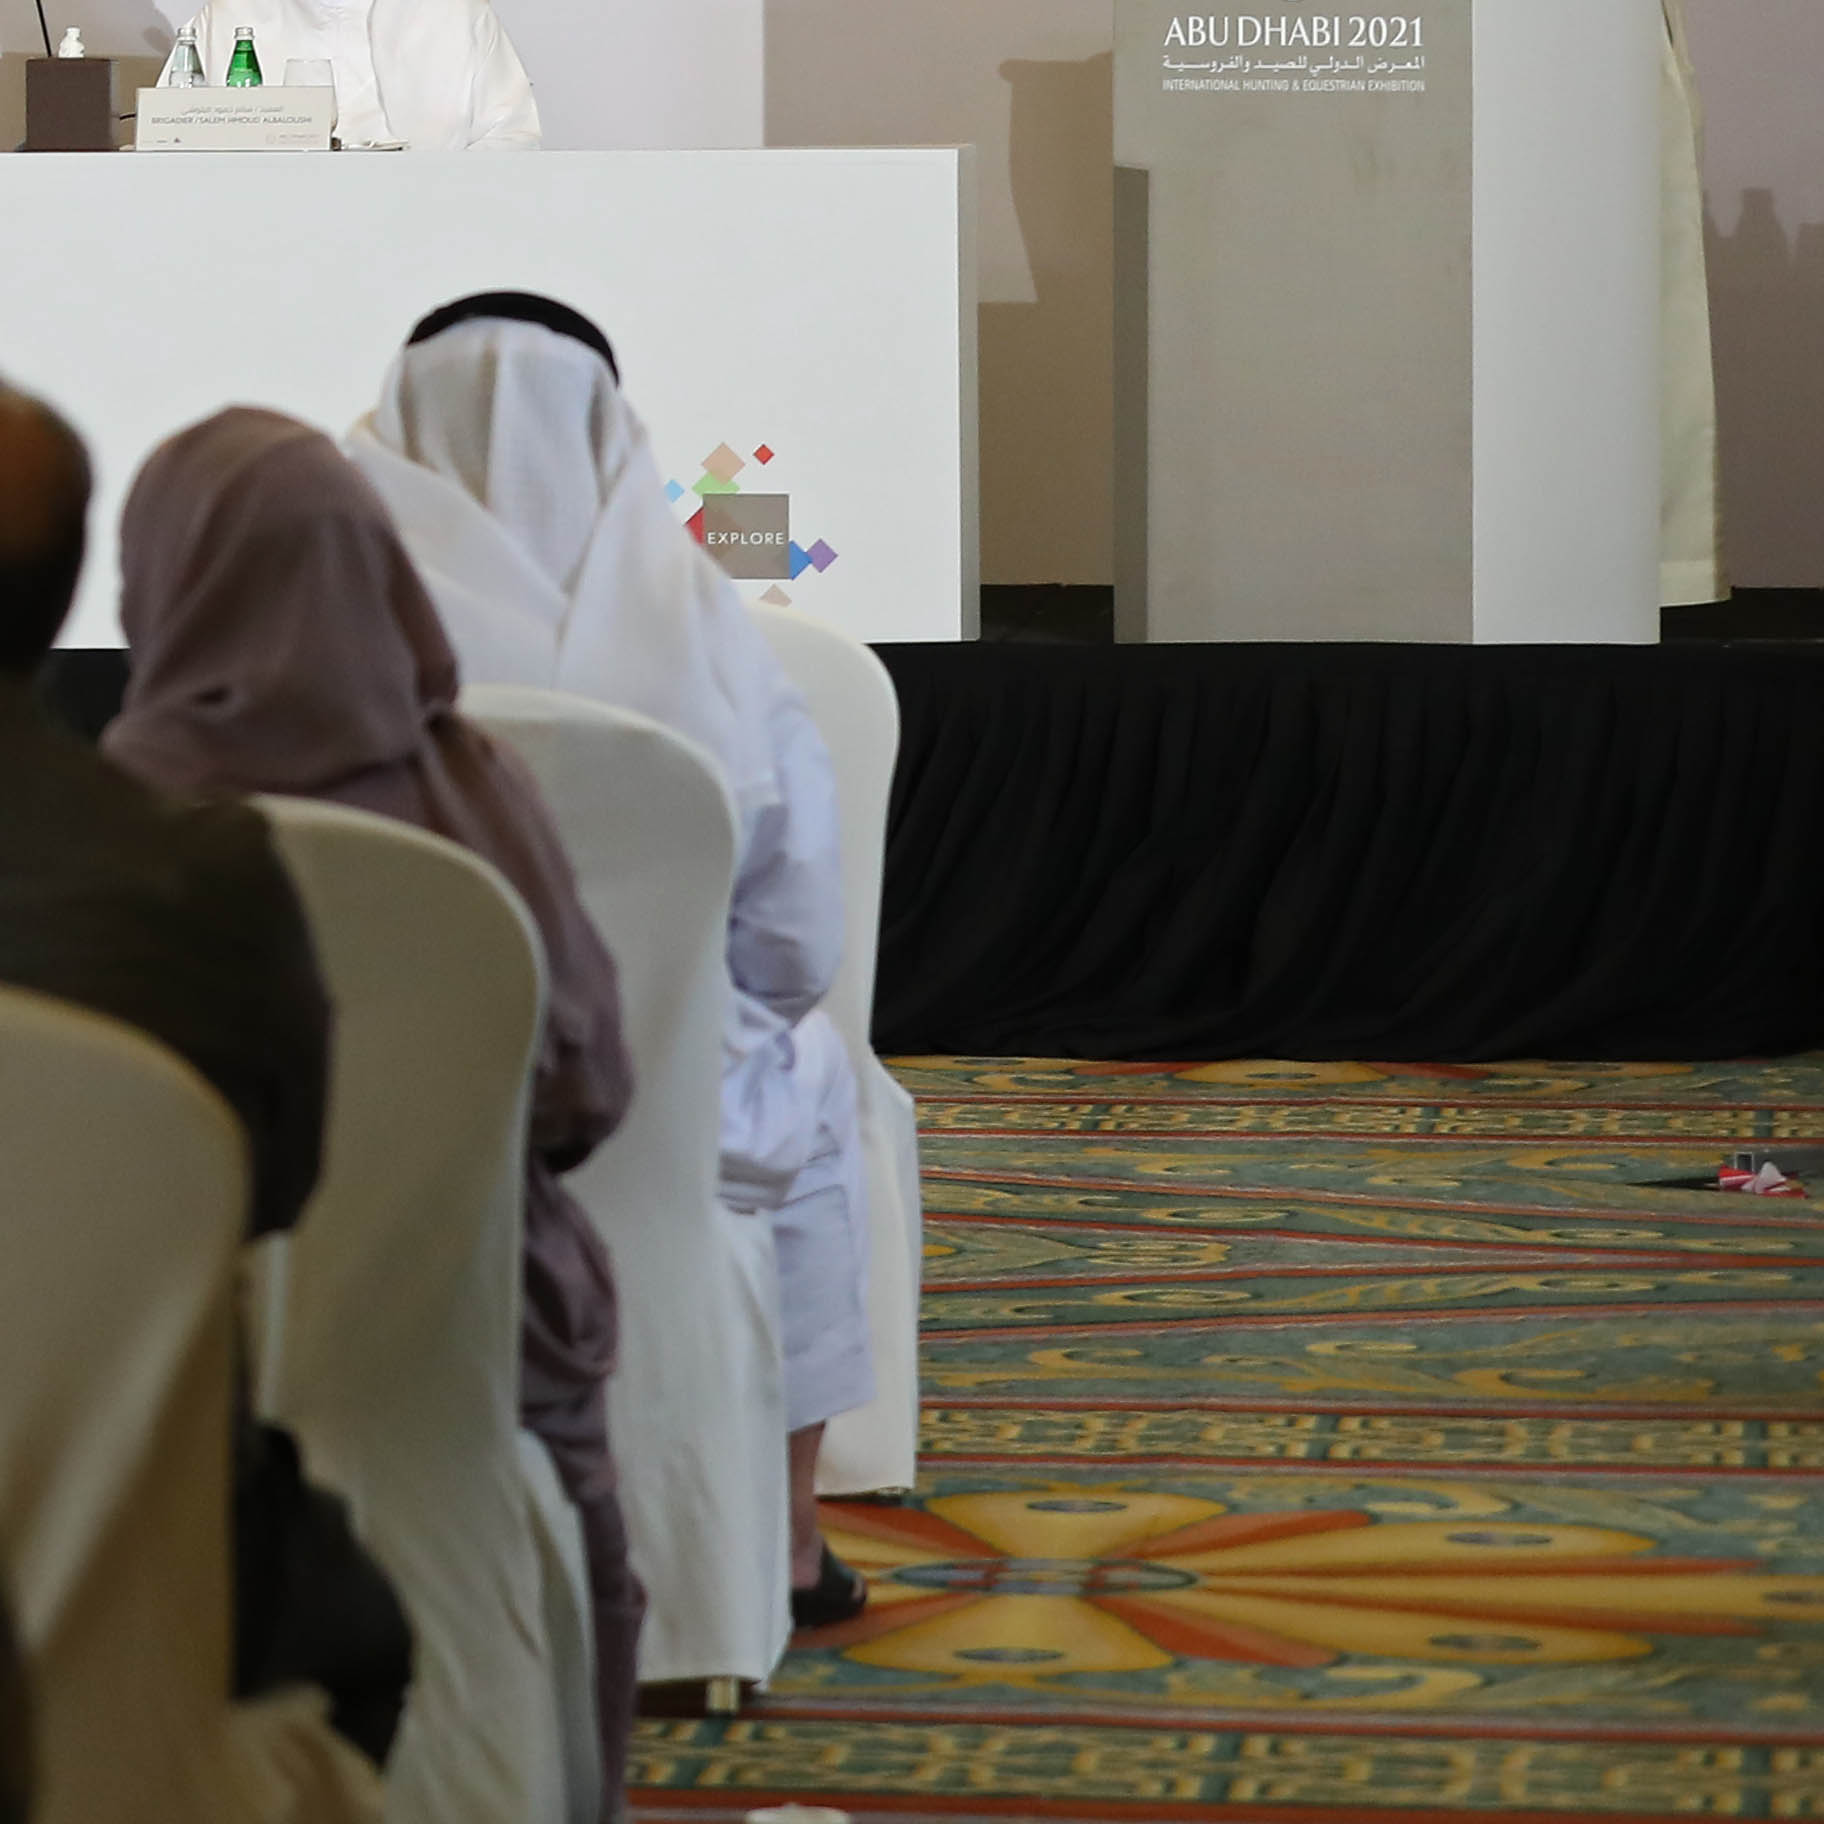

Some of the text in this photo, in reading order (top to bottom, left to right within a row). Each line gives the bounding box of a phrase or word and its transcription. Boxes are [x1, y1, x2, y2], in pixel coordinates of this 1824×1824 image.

[1162, 15, 1425, 48] ABU DHABI 2021
[1162, 54, 1425, 77] المعرض الدولي للصيد والفروسية
[1163, 79, 1425, 91] INTERNATIONAL HUNTING & EQUESTRIAN EXHIBITION
[708, 533, 783, 544] EXPLORE
